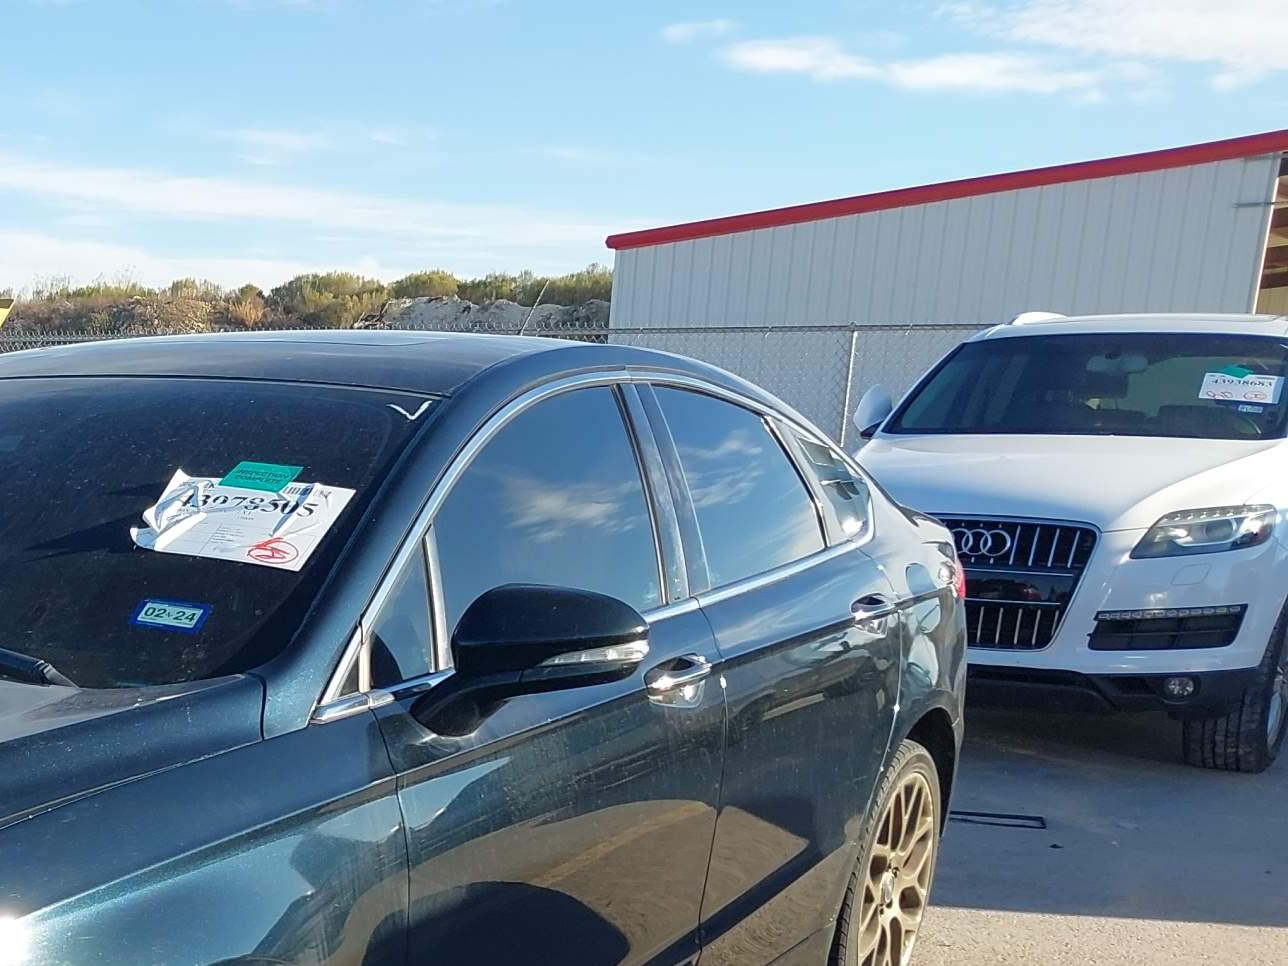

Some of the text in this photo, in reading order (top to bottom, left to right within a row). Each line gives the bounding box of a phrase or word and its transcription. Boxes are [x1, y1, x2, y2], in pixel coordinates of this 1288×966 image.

[234, 468, 289, 480] INSPECTION
[234, 474, 282, 486] COMPLETE
[143, 606, 197, 622] 02 24
